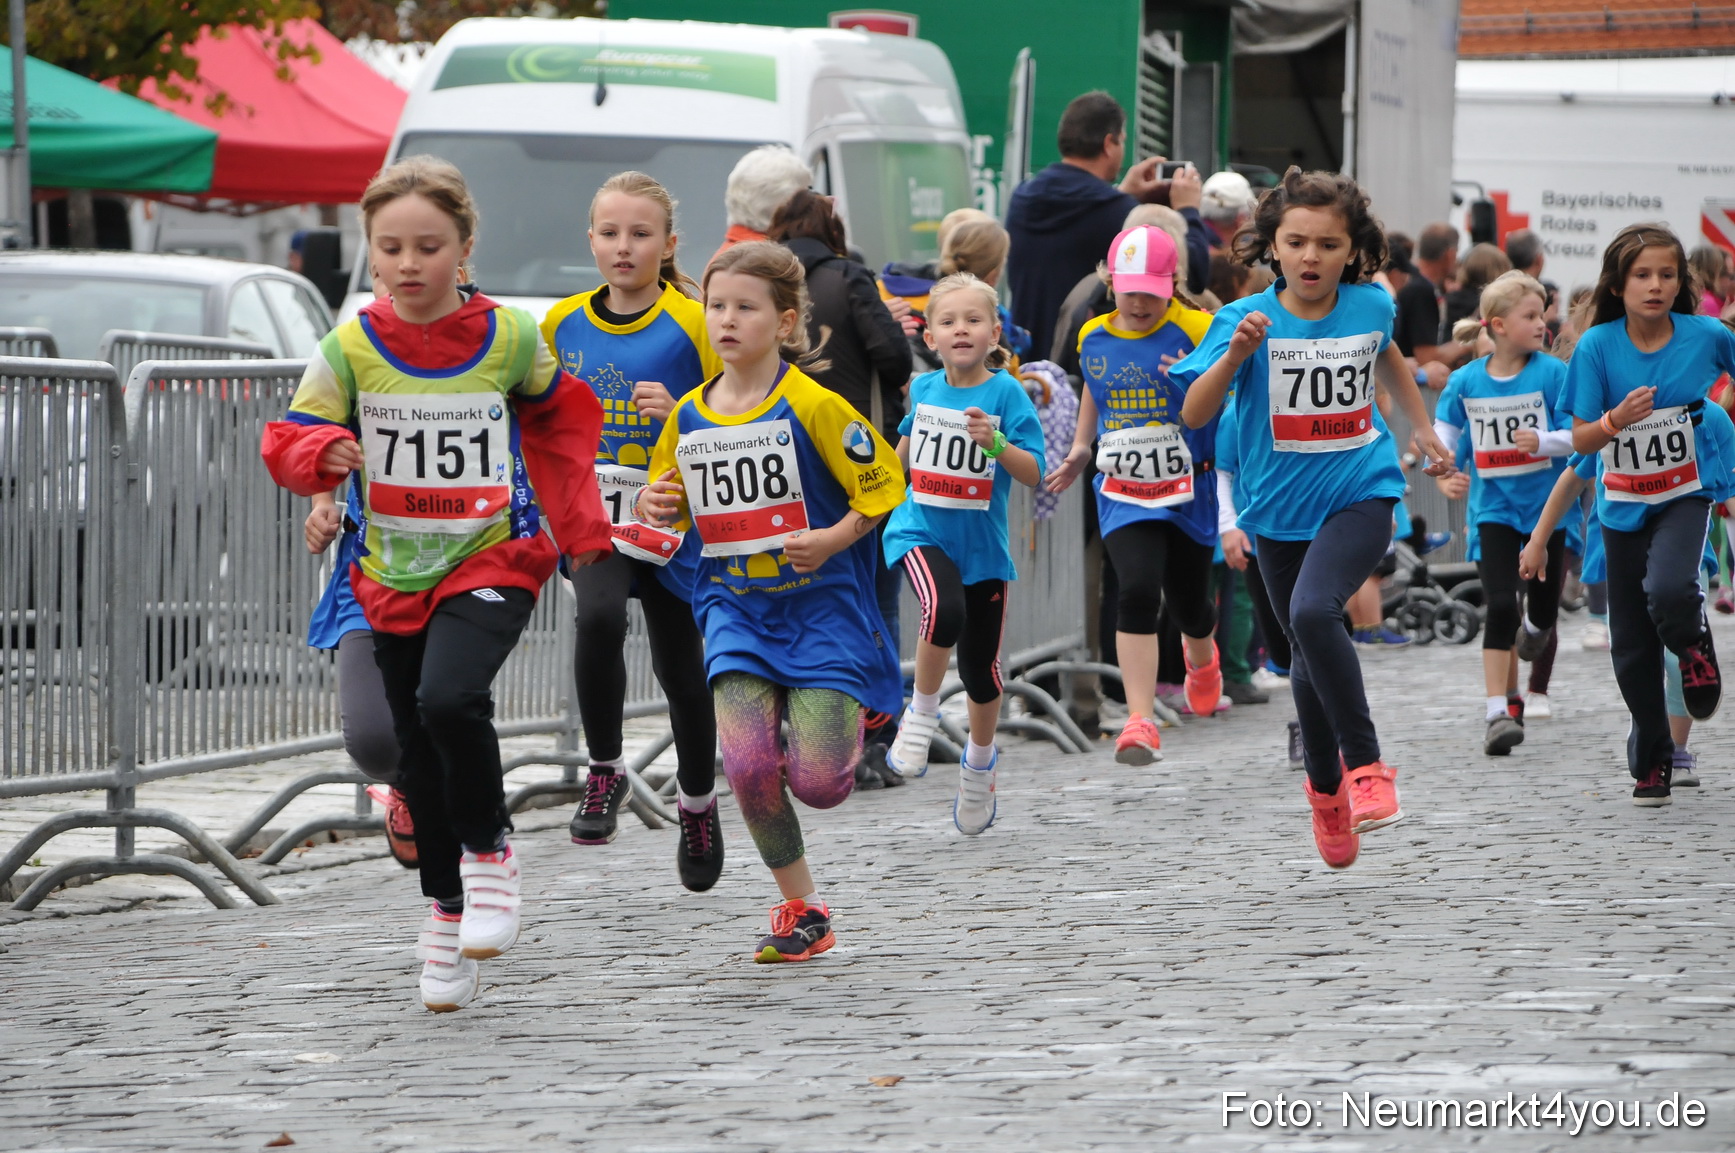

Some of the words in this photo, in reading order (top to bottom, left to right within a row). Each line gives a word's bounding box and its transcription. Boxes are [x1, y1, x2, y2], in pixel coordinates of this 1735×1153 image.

[1541, 189, 1663, 212] Bayerisches
[1541, 213, 1597, 232] Rotes
[1543, 239, 1596, 258] Kreuz
[1271, 350, 1312, 361] PARTL
[1316, 346, 1371, 360] Neumarkt
[1282, 360, 1372, 409] 7031
[363, 406, 407, 421] PARTL
[411, 408, 483, 421] Neumarkt
[1488, 402, 1530, 413] Neumarkt
[600, 429, 627, 438] ember
[629, 430, 651, 438] 2014
[937, 417, 968, 430] Neuma
[1311, 419, 1355, 437] Alicia
[677, 443, 712, 457] PARTL
[713, 436, 772, 453] Neumarkt
[915, 428, 988, 473] 7100
[1101, 438, 1126, 449] PARTL
[1128, 434, 1173, 445] Neumarkt
[1610, 429, 1687, 470] 7149
[376, 428, 490, 480] 7151
[1106, 446, 1184, 478] 7215
[689, 453, 789, 508] 7508
[857, 465, 890, 486] PARTL
[860, 475, 893, 495] Neumarkt
[919, 474, 963, 496] Sophia
[1630, 475, 1668, 493] Leoni
[405, 493, 465, 514] Selina
